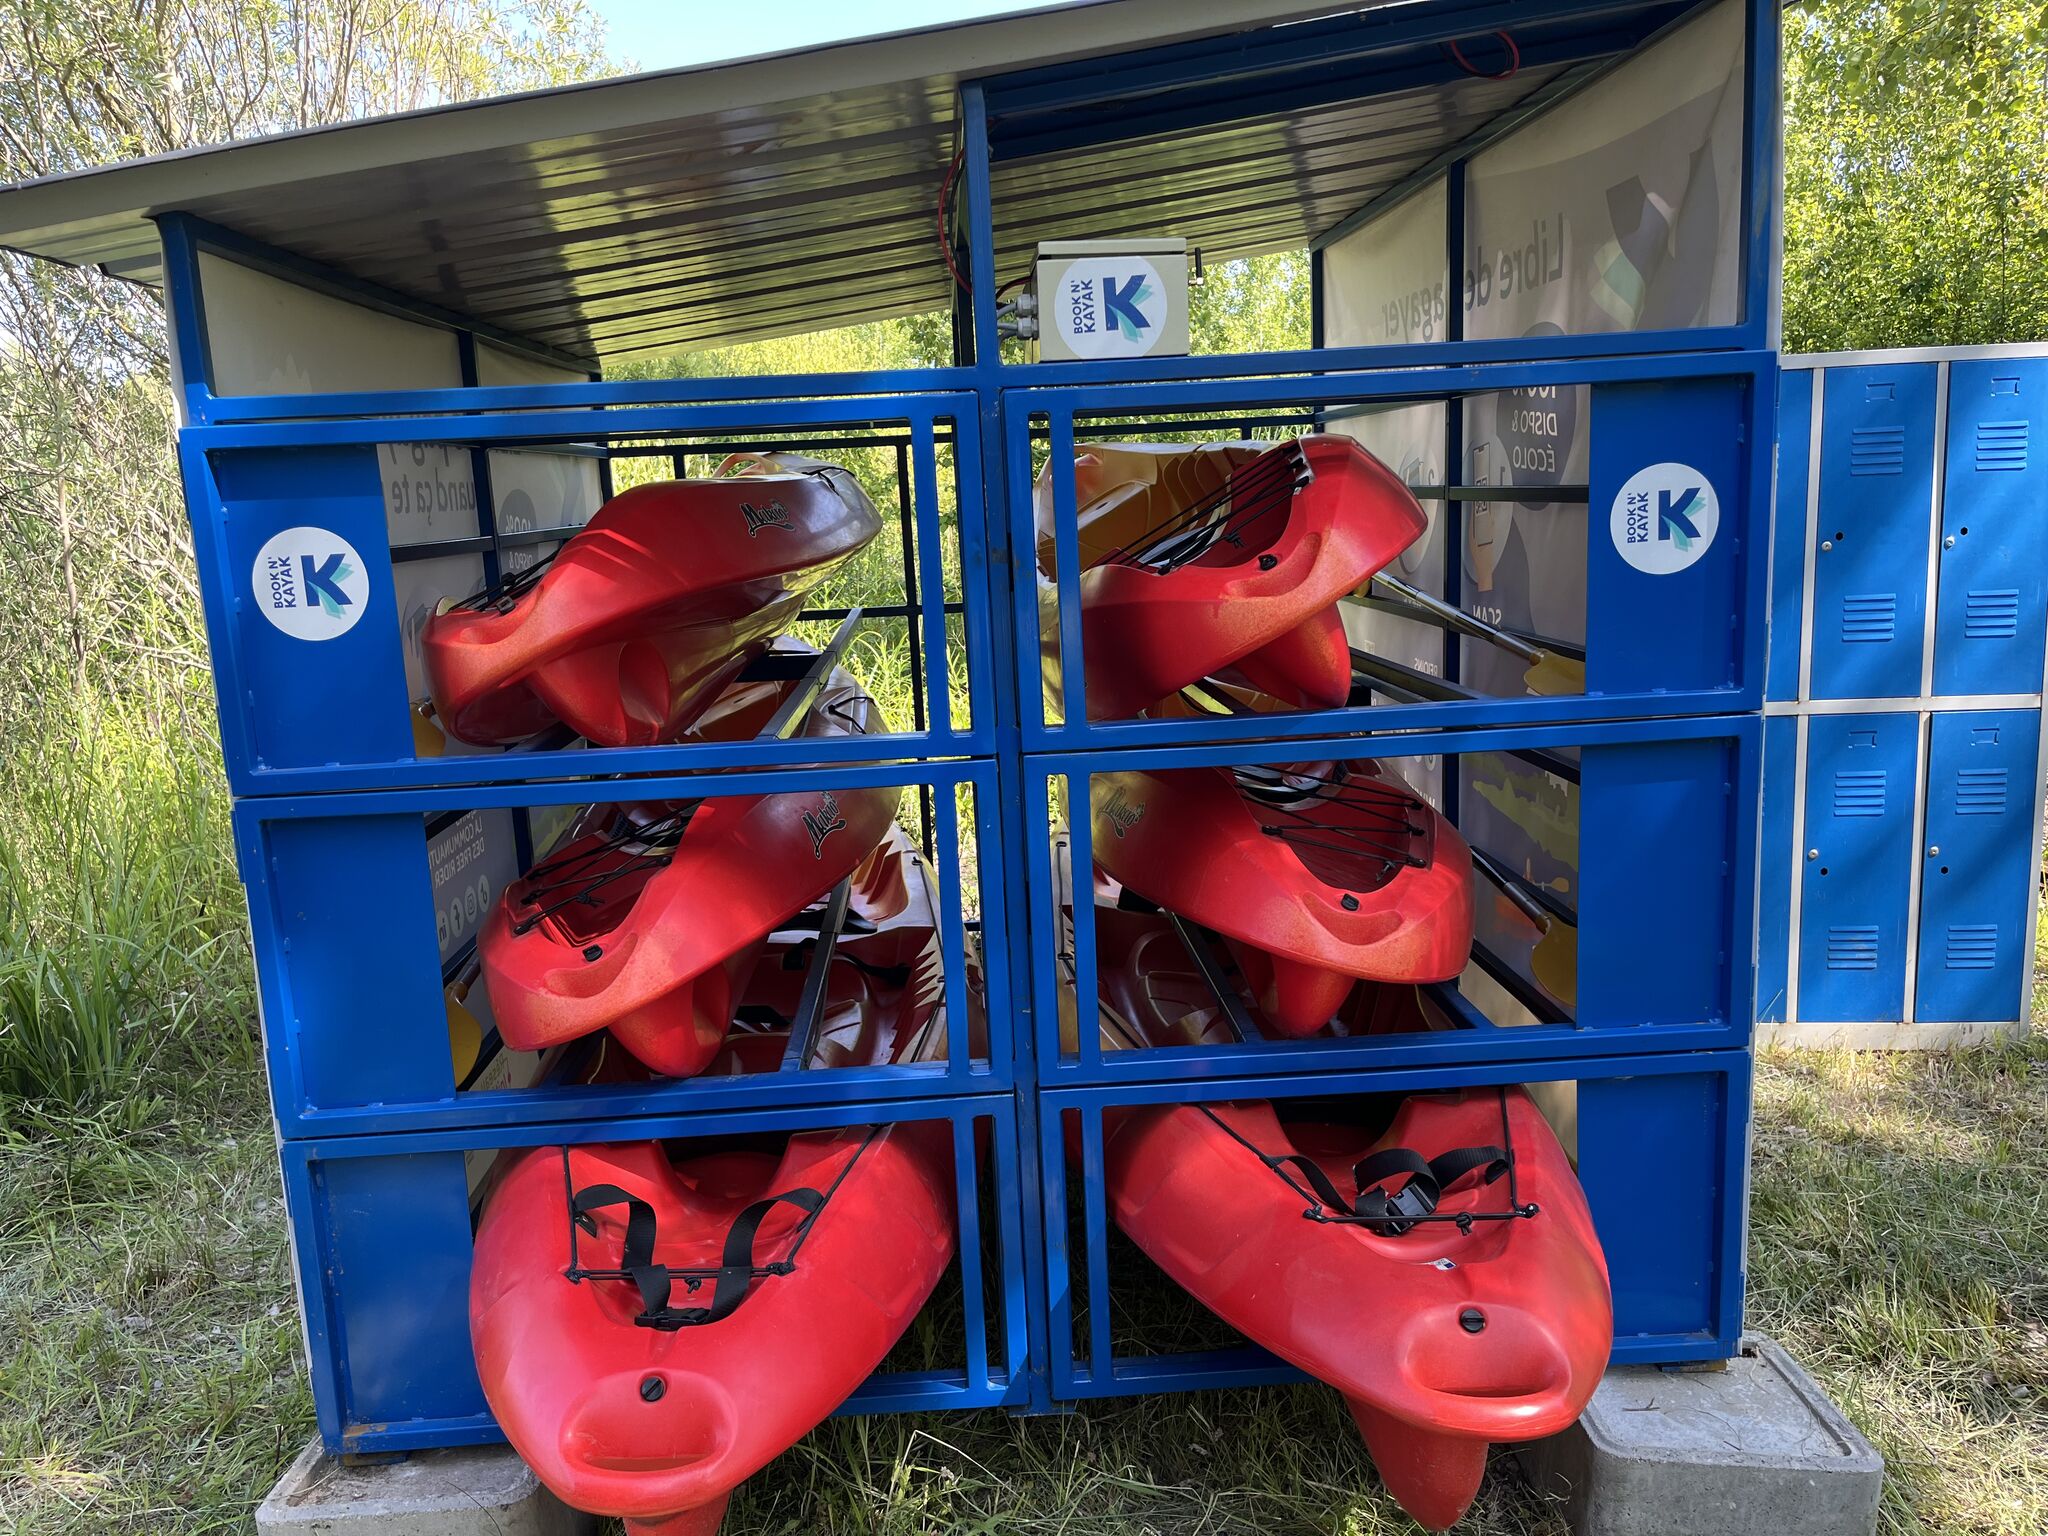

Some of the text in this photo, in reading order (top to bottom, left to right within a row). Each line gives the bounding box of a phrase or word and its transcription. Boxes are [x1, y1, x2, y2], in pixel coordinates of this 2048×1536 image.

[1071, 293, 1084, 334] BOOK
[1081, 278, 1096, 334] KAYAK
[1627, 507, 1637, 544] BOOK
[1637, 491, 1649, 544] KAYAK
[269, 572, 284, 609] BOOK
[278, 555, 297, 608] KAYAK
